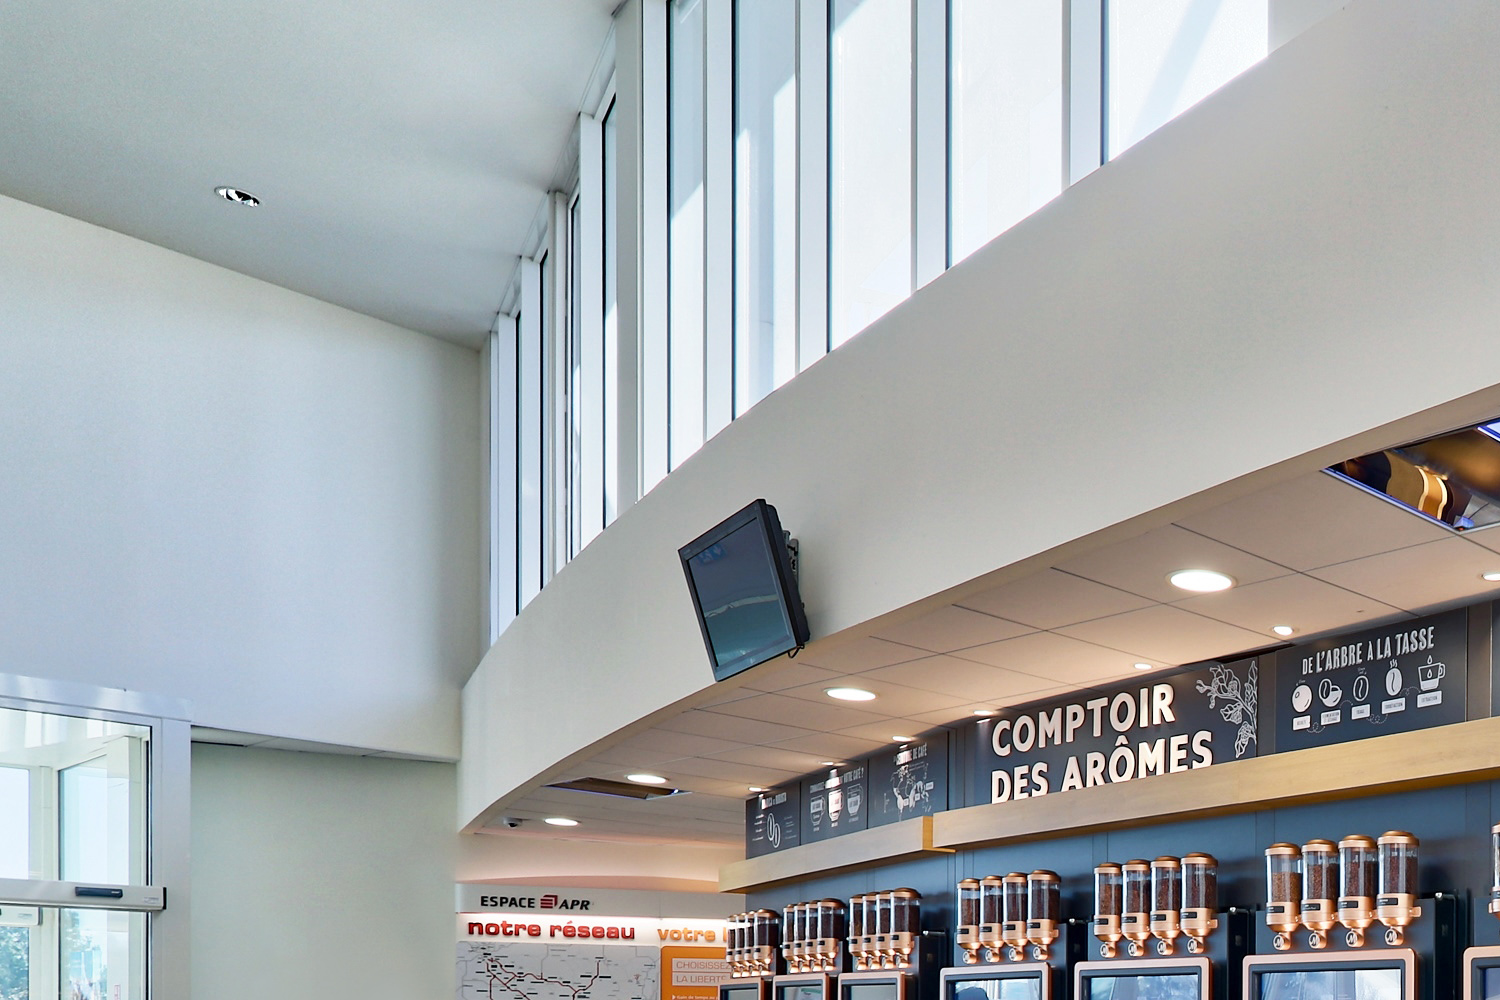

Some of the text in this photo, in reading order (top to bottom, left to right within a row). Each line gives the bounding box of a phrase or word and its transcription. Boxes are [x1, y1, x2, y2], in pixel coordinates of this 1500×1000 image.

[1302, 626, 1435, 675] DE L'ARBRE À LA TASSE
[992, 683, 1176, 757] COMPTOIR
[991, 730, 1213, 804] DES ARÔMES
[480, 895, 591, 911] ESPACE APR
[468, 920, 635, 940] notre réseau
[657, 927, 716, 942] votre
